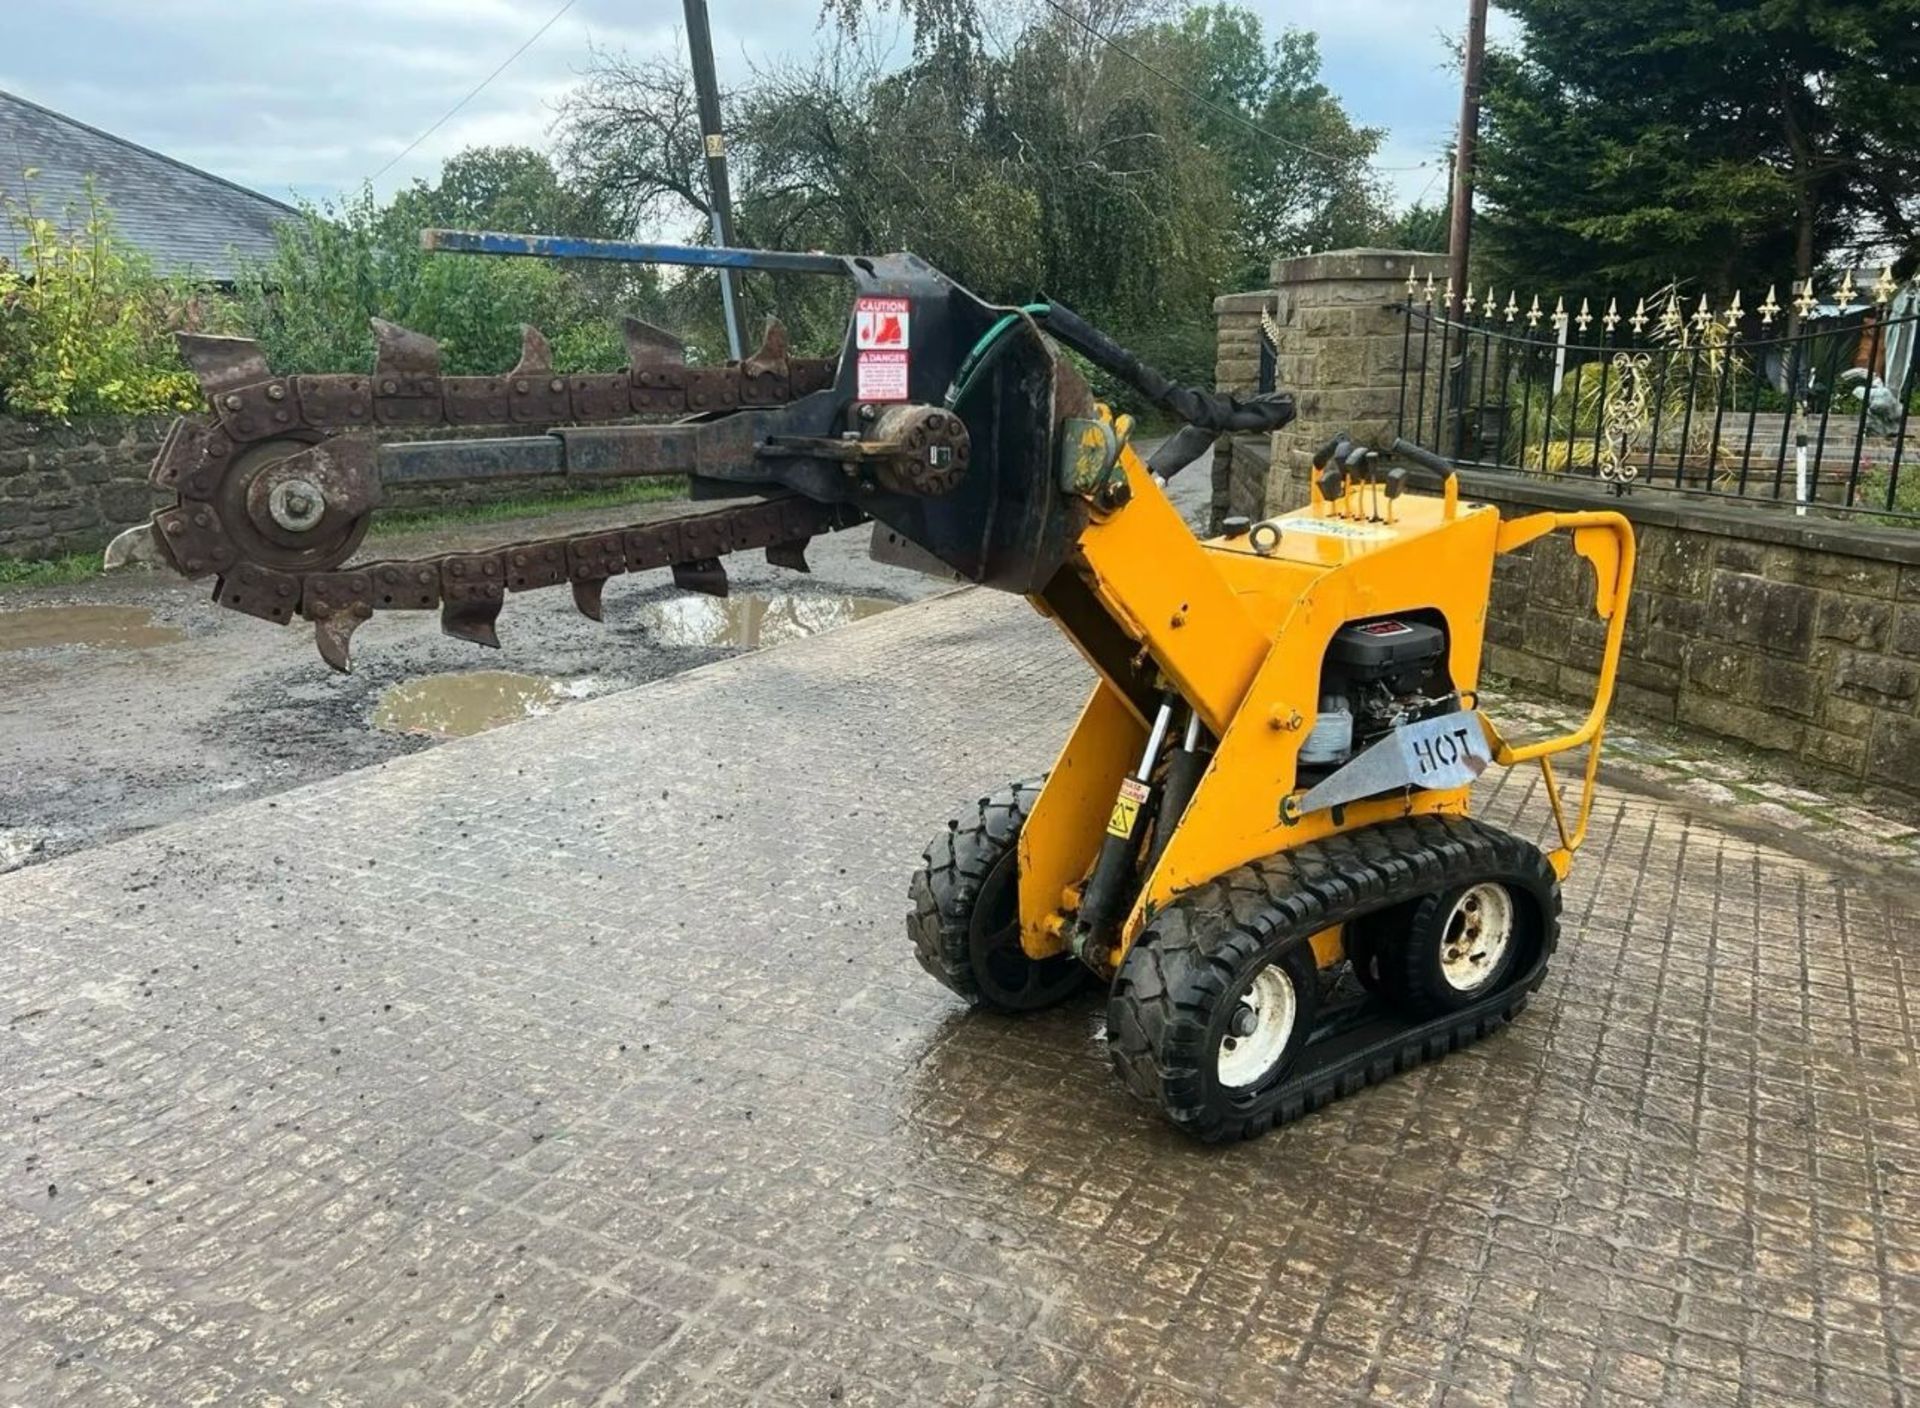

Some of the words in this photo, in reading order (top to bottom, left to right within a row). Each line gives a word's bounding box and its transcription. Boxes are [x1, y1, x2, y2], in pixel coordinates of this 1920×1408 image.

[860, 300, 906, 312] CAUTION
[869, 353, 906, 363] DANGER
[1413, 728, 1471, 774] HOT
